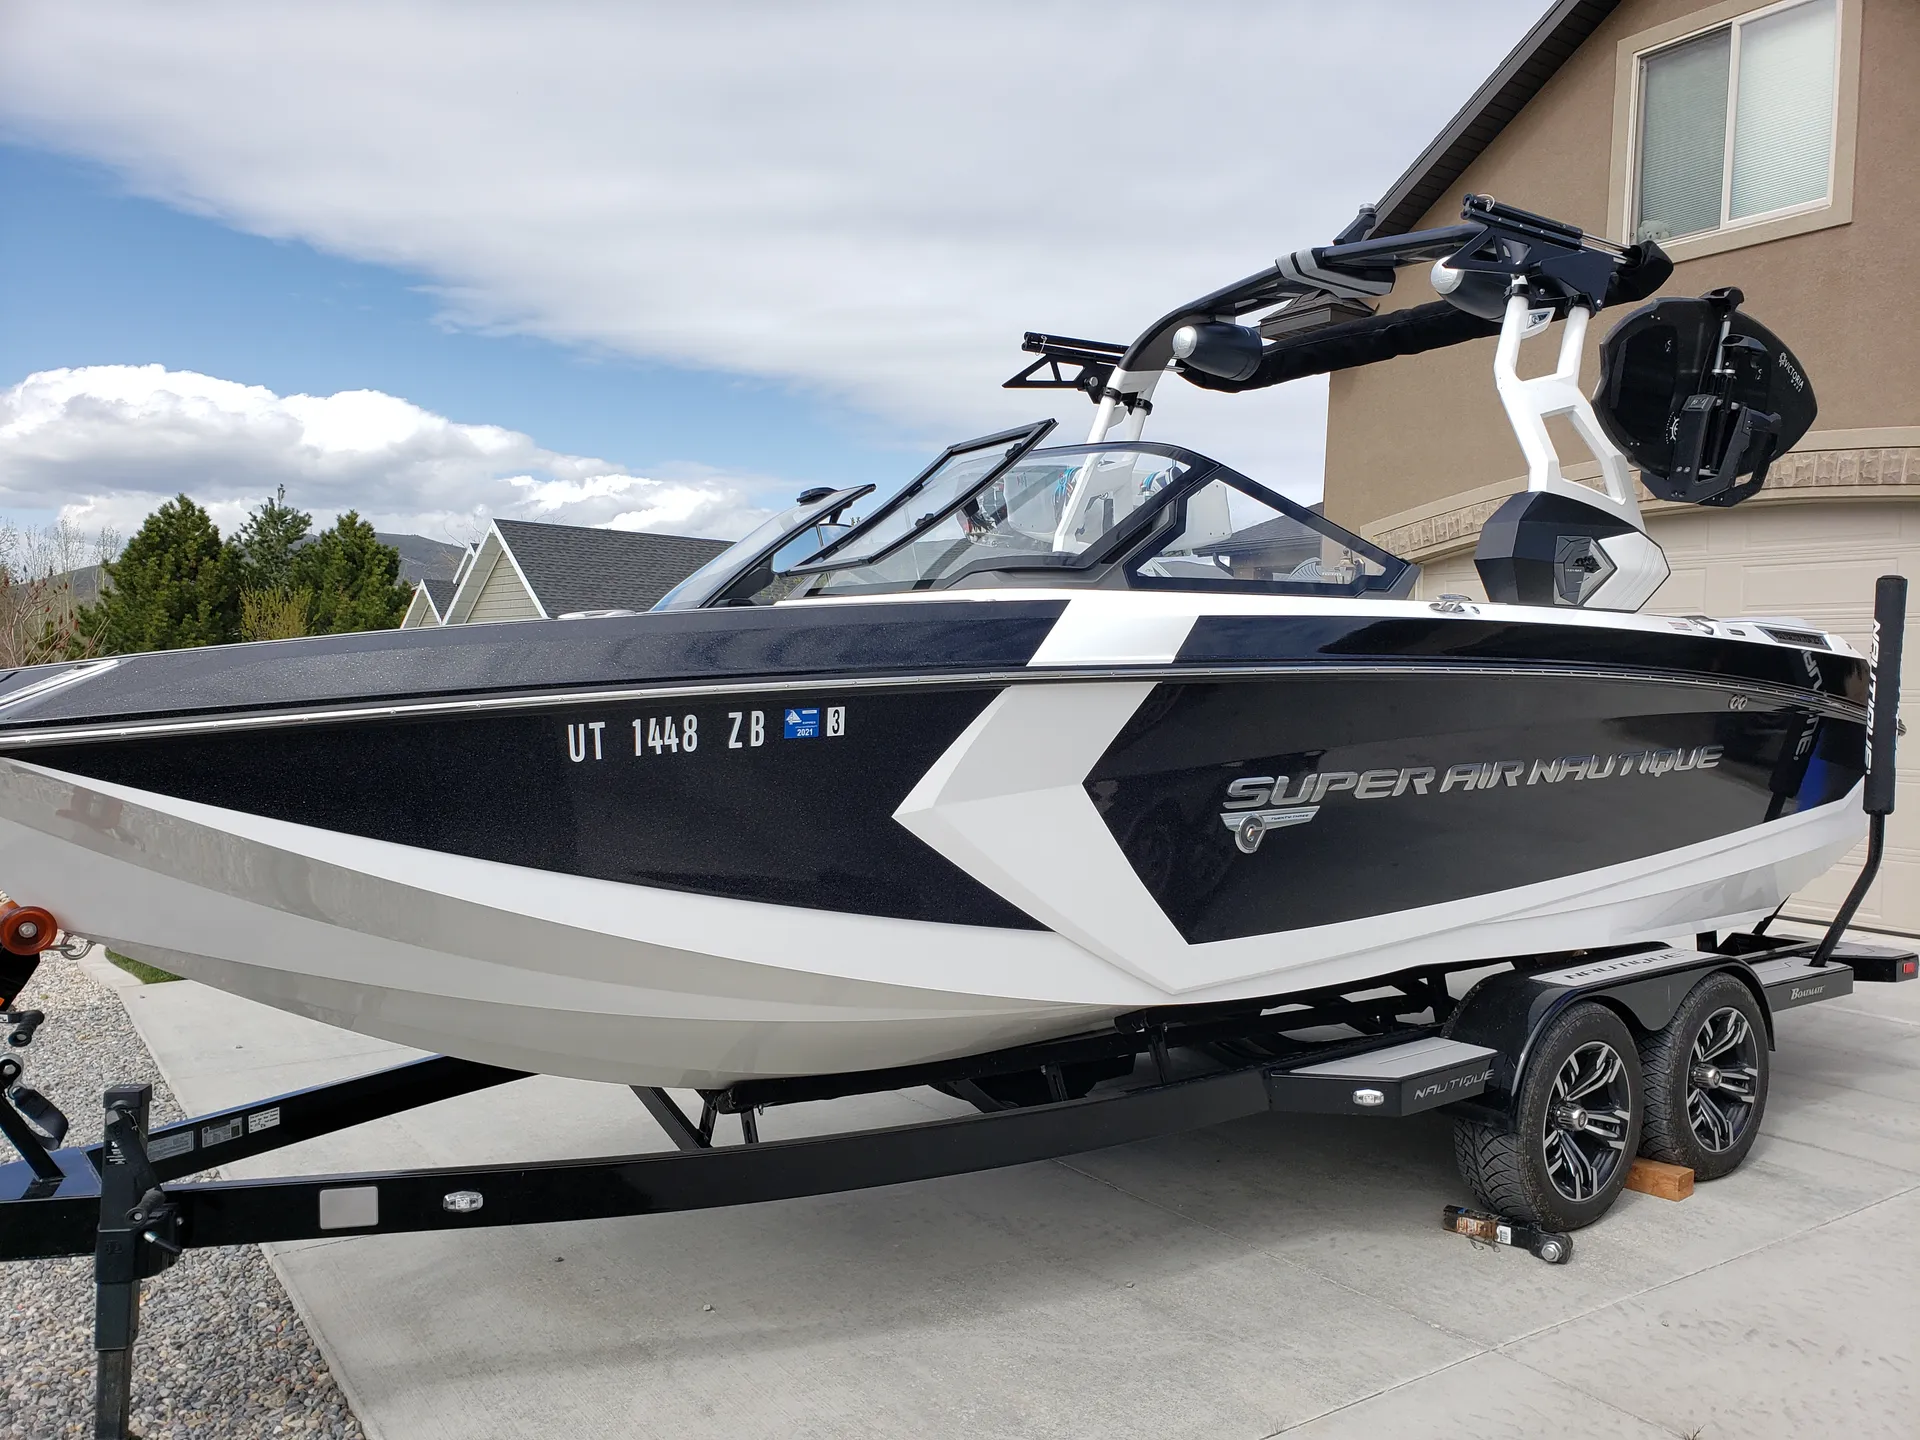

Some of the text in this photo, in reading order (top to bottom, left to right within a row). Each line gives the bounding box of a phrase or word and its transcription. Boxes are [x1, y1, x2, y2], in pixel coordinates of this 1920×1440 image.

[1784, 360, 1804, 388] VICTORIA
[1865, 618, 1881, 772] NAUTIQUE
[567, 710, 765, 763] UT 1448 ZB
[796, 728, 813, 737] 2021
[832, 709, 840, 734] 3
[1223, 745, 1725, 809] SUPER AIR NAUTIQUE
[1564, 951, 1685, 980] NAUTIQUE
[1413, 1068, 1495, 1100] NAUTIQUE
